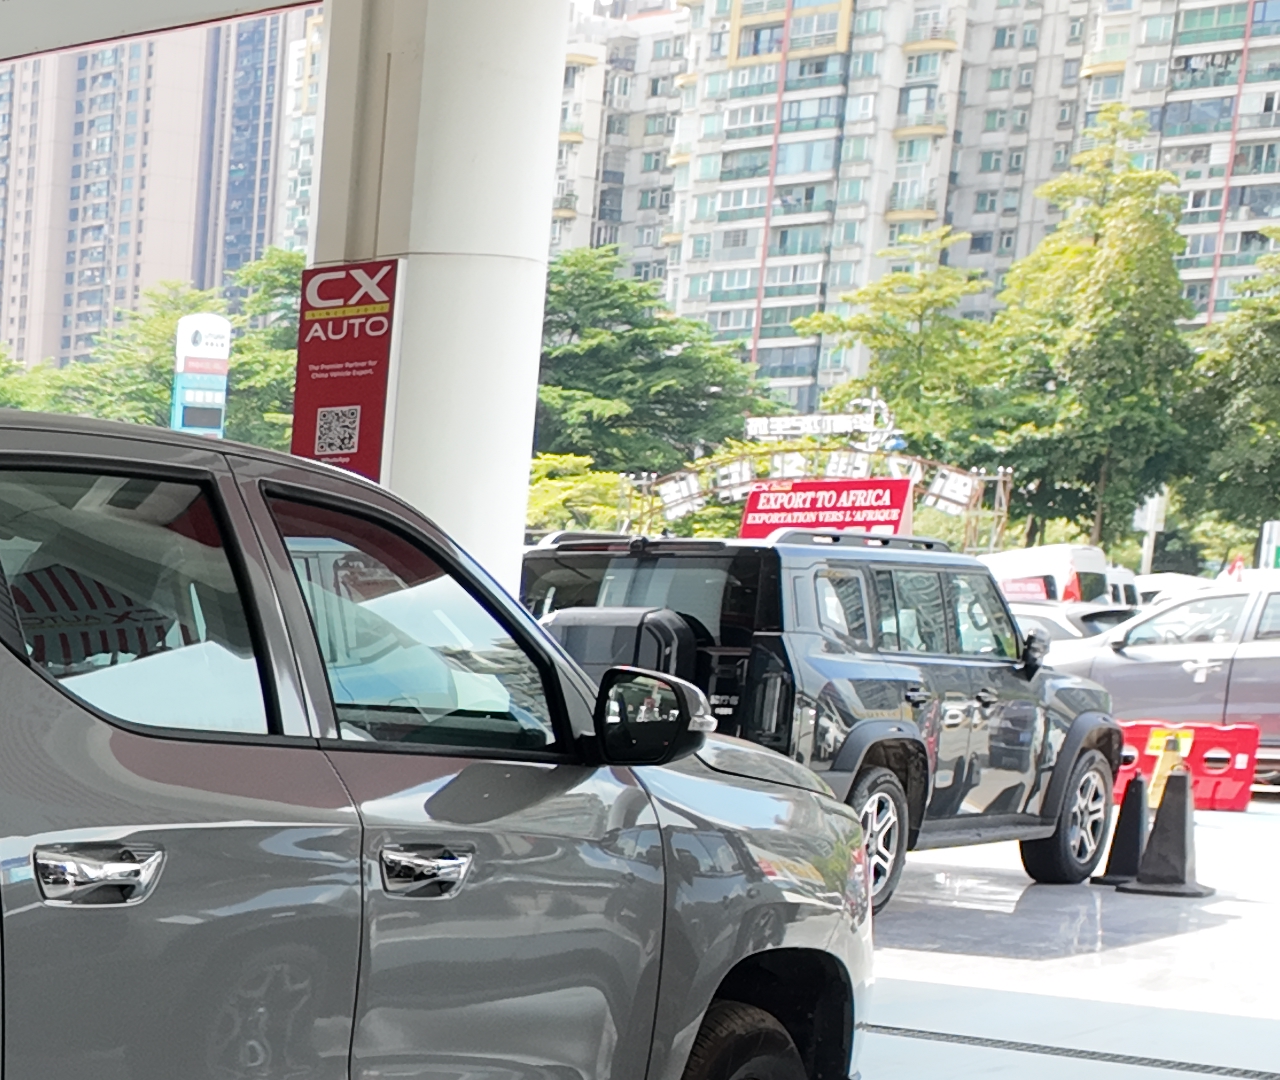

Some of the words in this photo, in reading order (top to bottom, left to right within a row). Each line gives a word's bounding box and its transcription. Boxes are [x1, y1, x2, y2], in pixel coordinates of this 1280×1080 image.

[305, 265, 393, 308] CX
[304, 316, 389, 343] AUTO
[757, 492, 815, 509] EXPORT
[815, 490, 837, 509] TO
[837, 489, 891, 508] AFRICA
[746, 511, 818, 524] EXPORTATION
[818, 510, 844, 523] VERS
